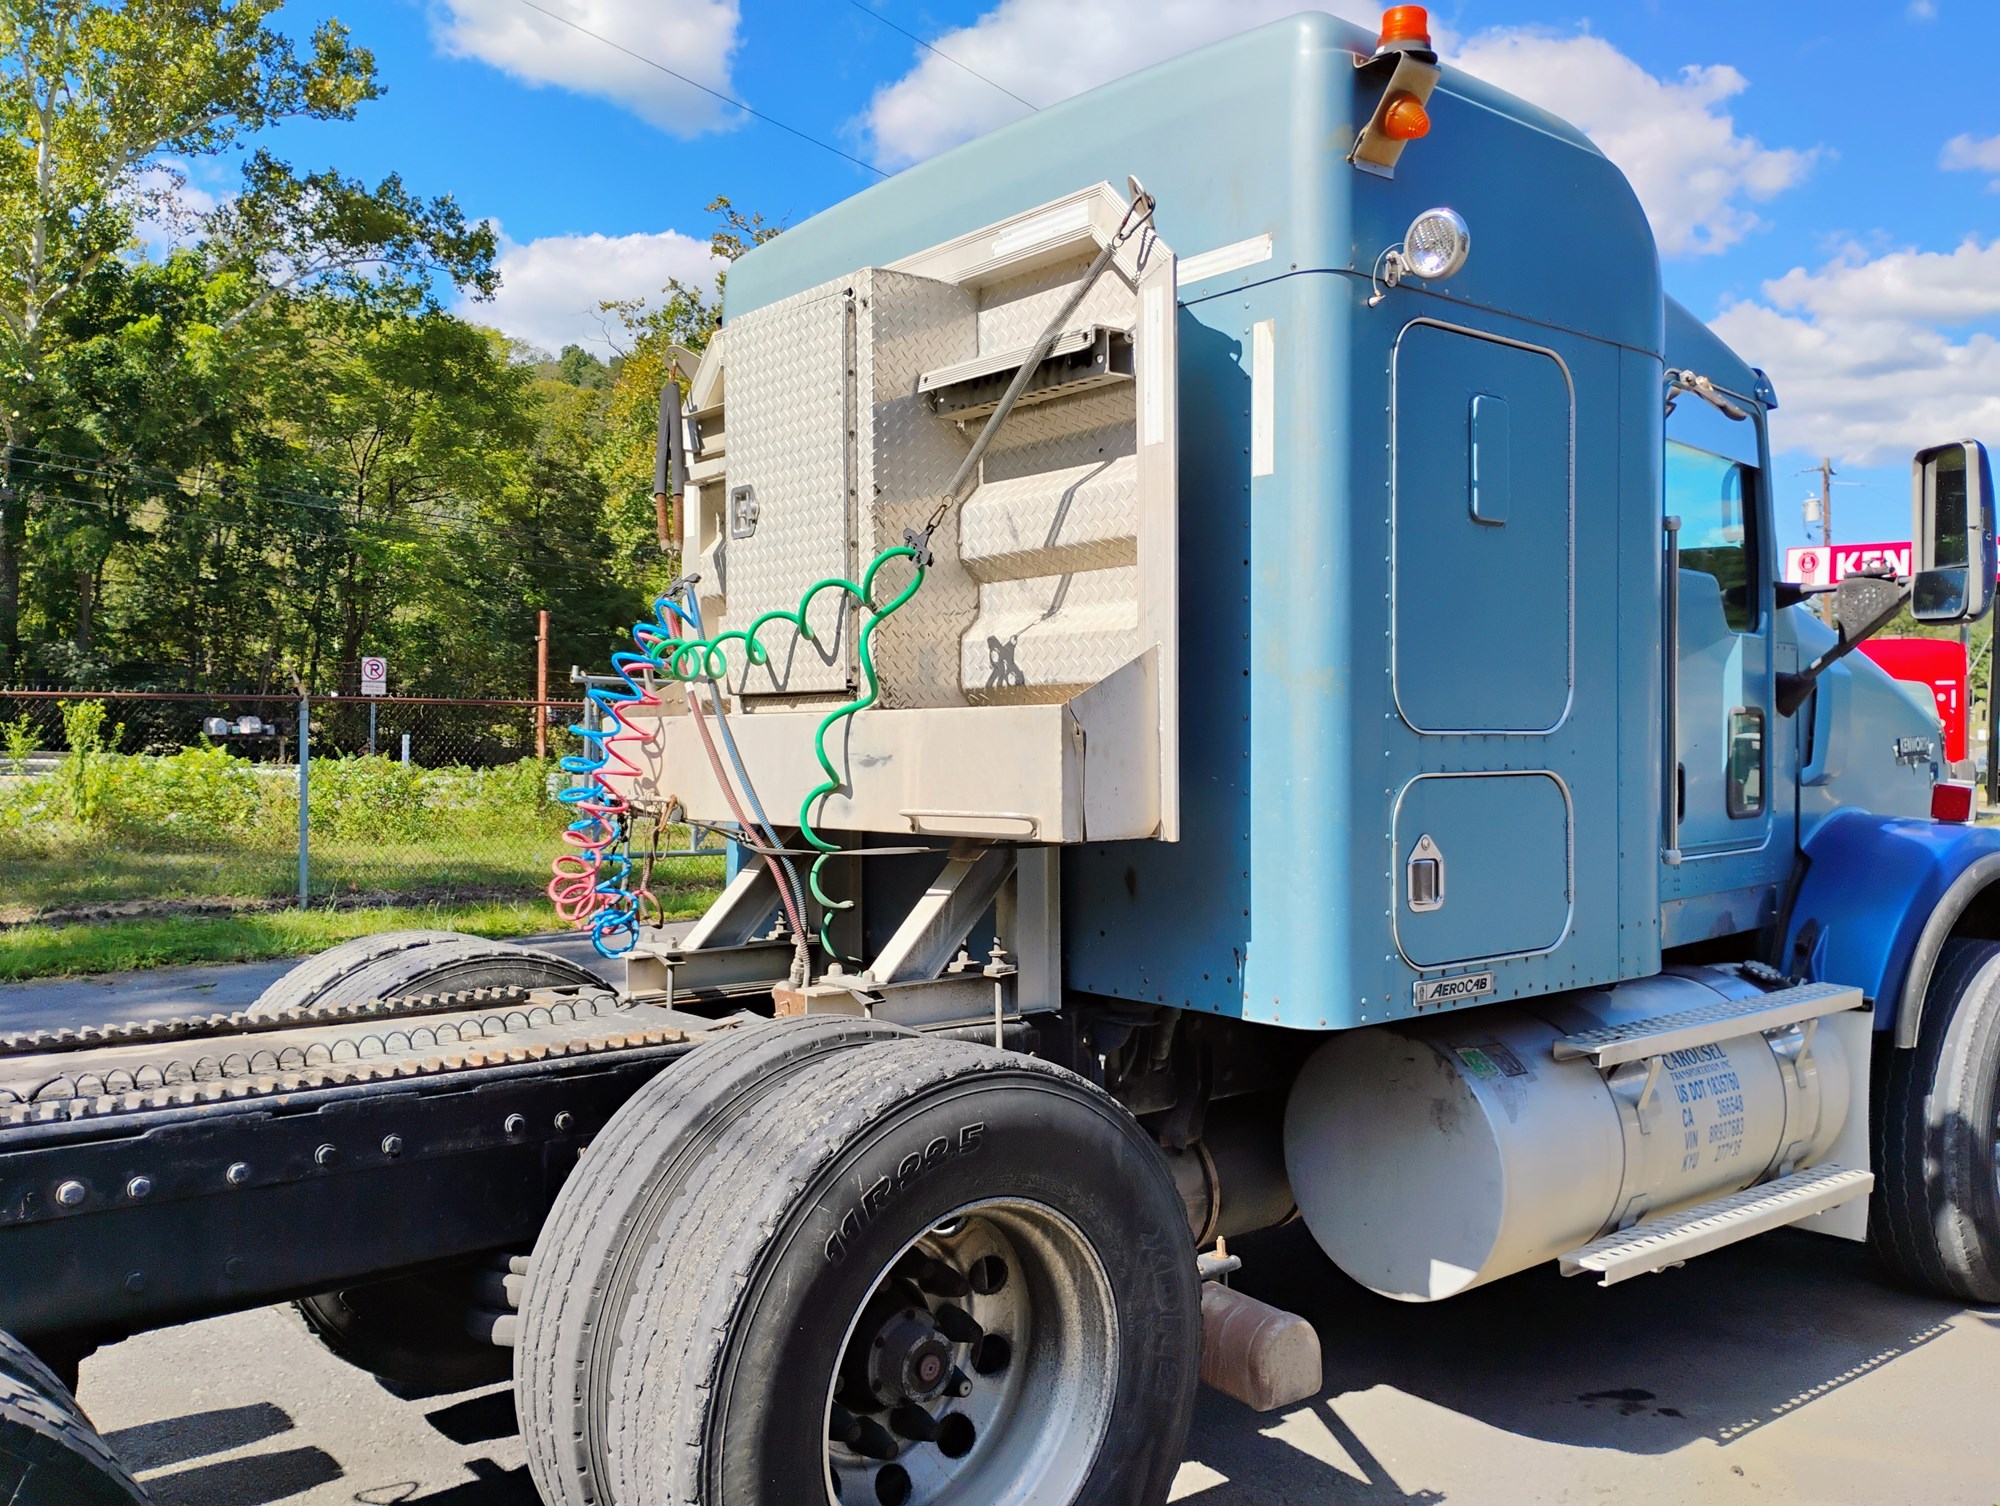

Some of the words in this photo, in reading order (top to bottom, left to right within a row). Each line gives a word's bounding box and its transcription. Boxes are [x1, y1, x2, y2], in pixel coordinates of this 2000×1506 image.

[1429, 977, 1488, 998] AEROCAB
[1662, 1042, 1727, 1070] CAROUSEL
[1670, 1062, 1722, 1081] TRANSPORTATION
[1674, 1083, 1689, 1103] US
[1688, 1079, 1707, 1101] DOT
[1682, 1107, 1695, 1128] CA
[1684, 1130, 1698, 1150] VIN
